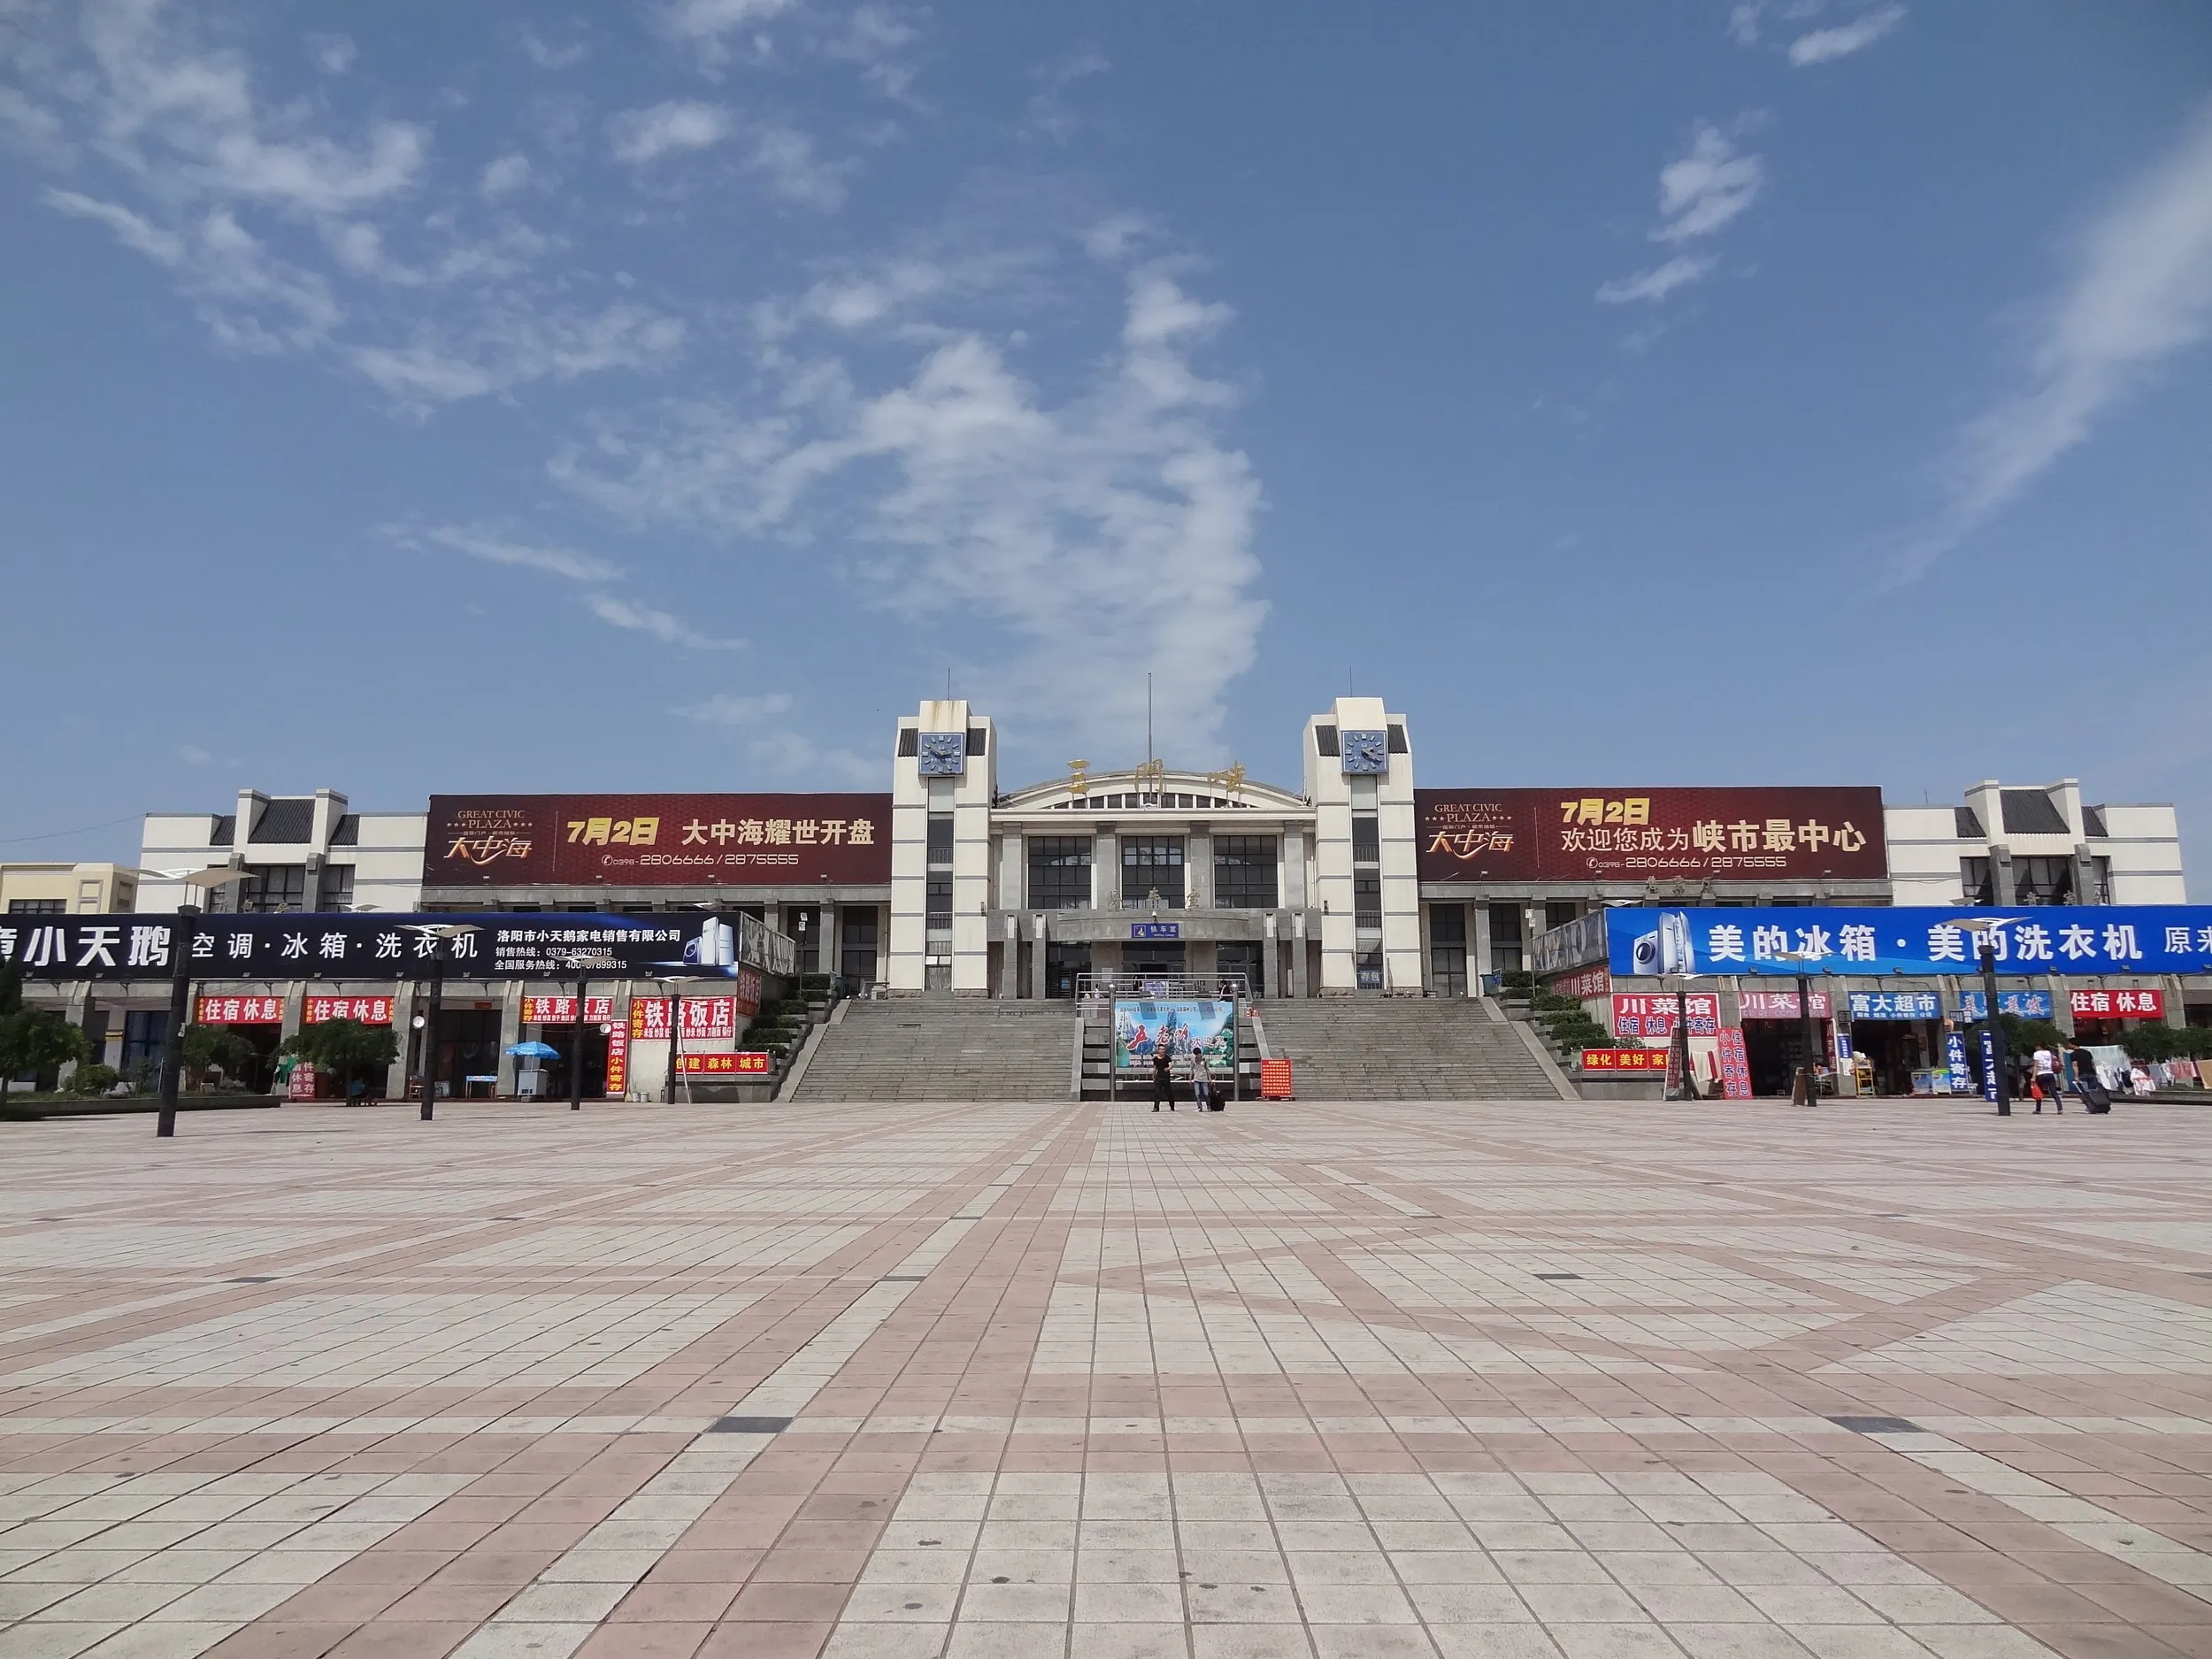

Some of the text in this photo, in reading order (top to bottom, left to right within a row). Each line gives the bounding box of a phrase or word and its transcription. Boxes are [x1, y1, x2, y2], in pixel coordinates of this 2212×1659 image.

[495, 810, 526, 818] CIVIC
[1434, 803, 1503, 812] GREAT CIVIC
[1561, 798, 1651, 826] 7月2日
[468, 819, 512, 829] PLAZA
[1446, 813, 1491, 822] PLAZA
[567, 817, 660, 846] 7月2日
[681, 818, 875, 846] 大中海耀世开盘
[1561, 818, 1867, 853] 欢迎您成为峡市最中心
[443, 835, 533, 866] 大中海
[1425, 829, 1515, 860] 大中海
[497, 930, 681, 942] 洛阳市小天鹅家电销售有限公司
[1361, 972, 1380, 981] 存包
[524, 998, 534, 1021] 小件寄存
[1619, 998, 1711, 1015] 川菜馆
[1850, 995, 1936, 1012] 富大超市
[632, 1001, 644, 1038] 小件寄存
[1617, 1016, 1640, 1034] 住宿
[1645, 1016, 1667, 1034] 休息
[708, 1057, 732, 1069] 森林
[740, 1057, 765, 1069] 城市
[1586, 1054, 1669, 1066] 绿化 美好 家
[1947, 1035, 1967, 1089] 小件寄存
